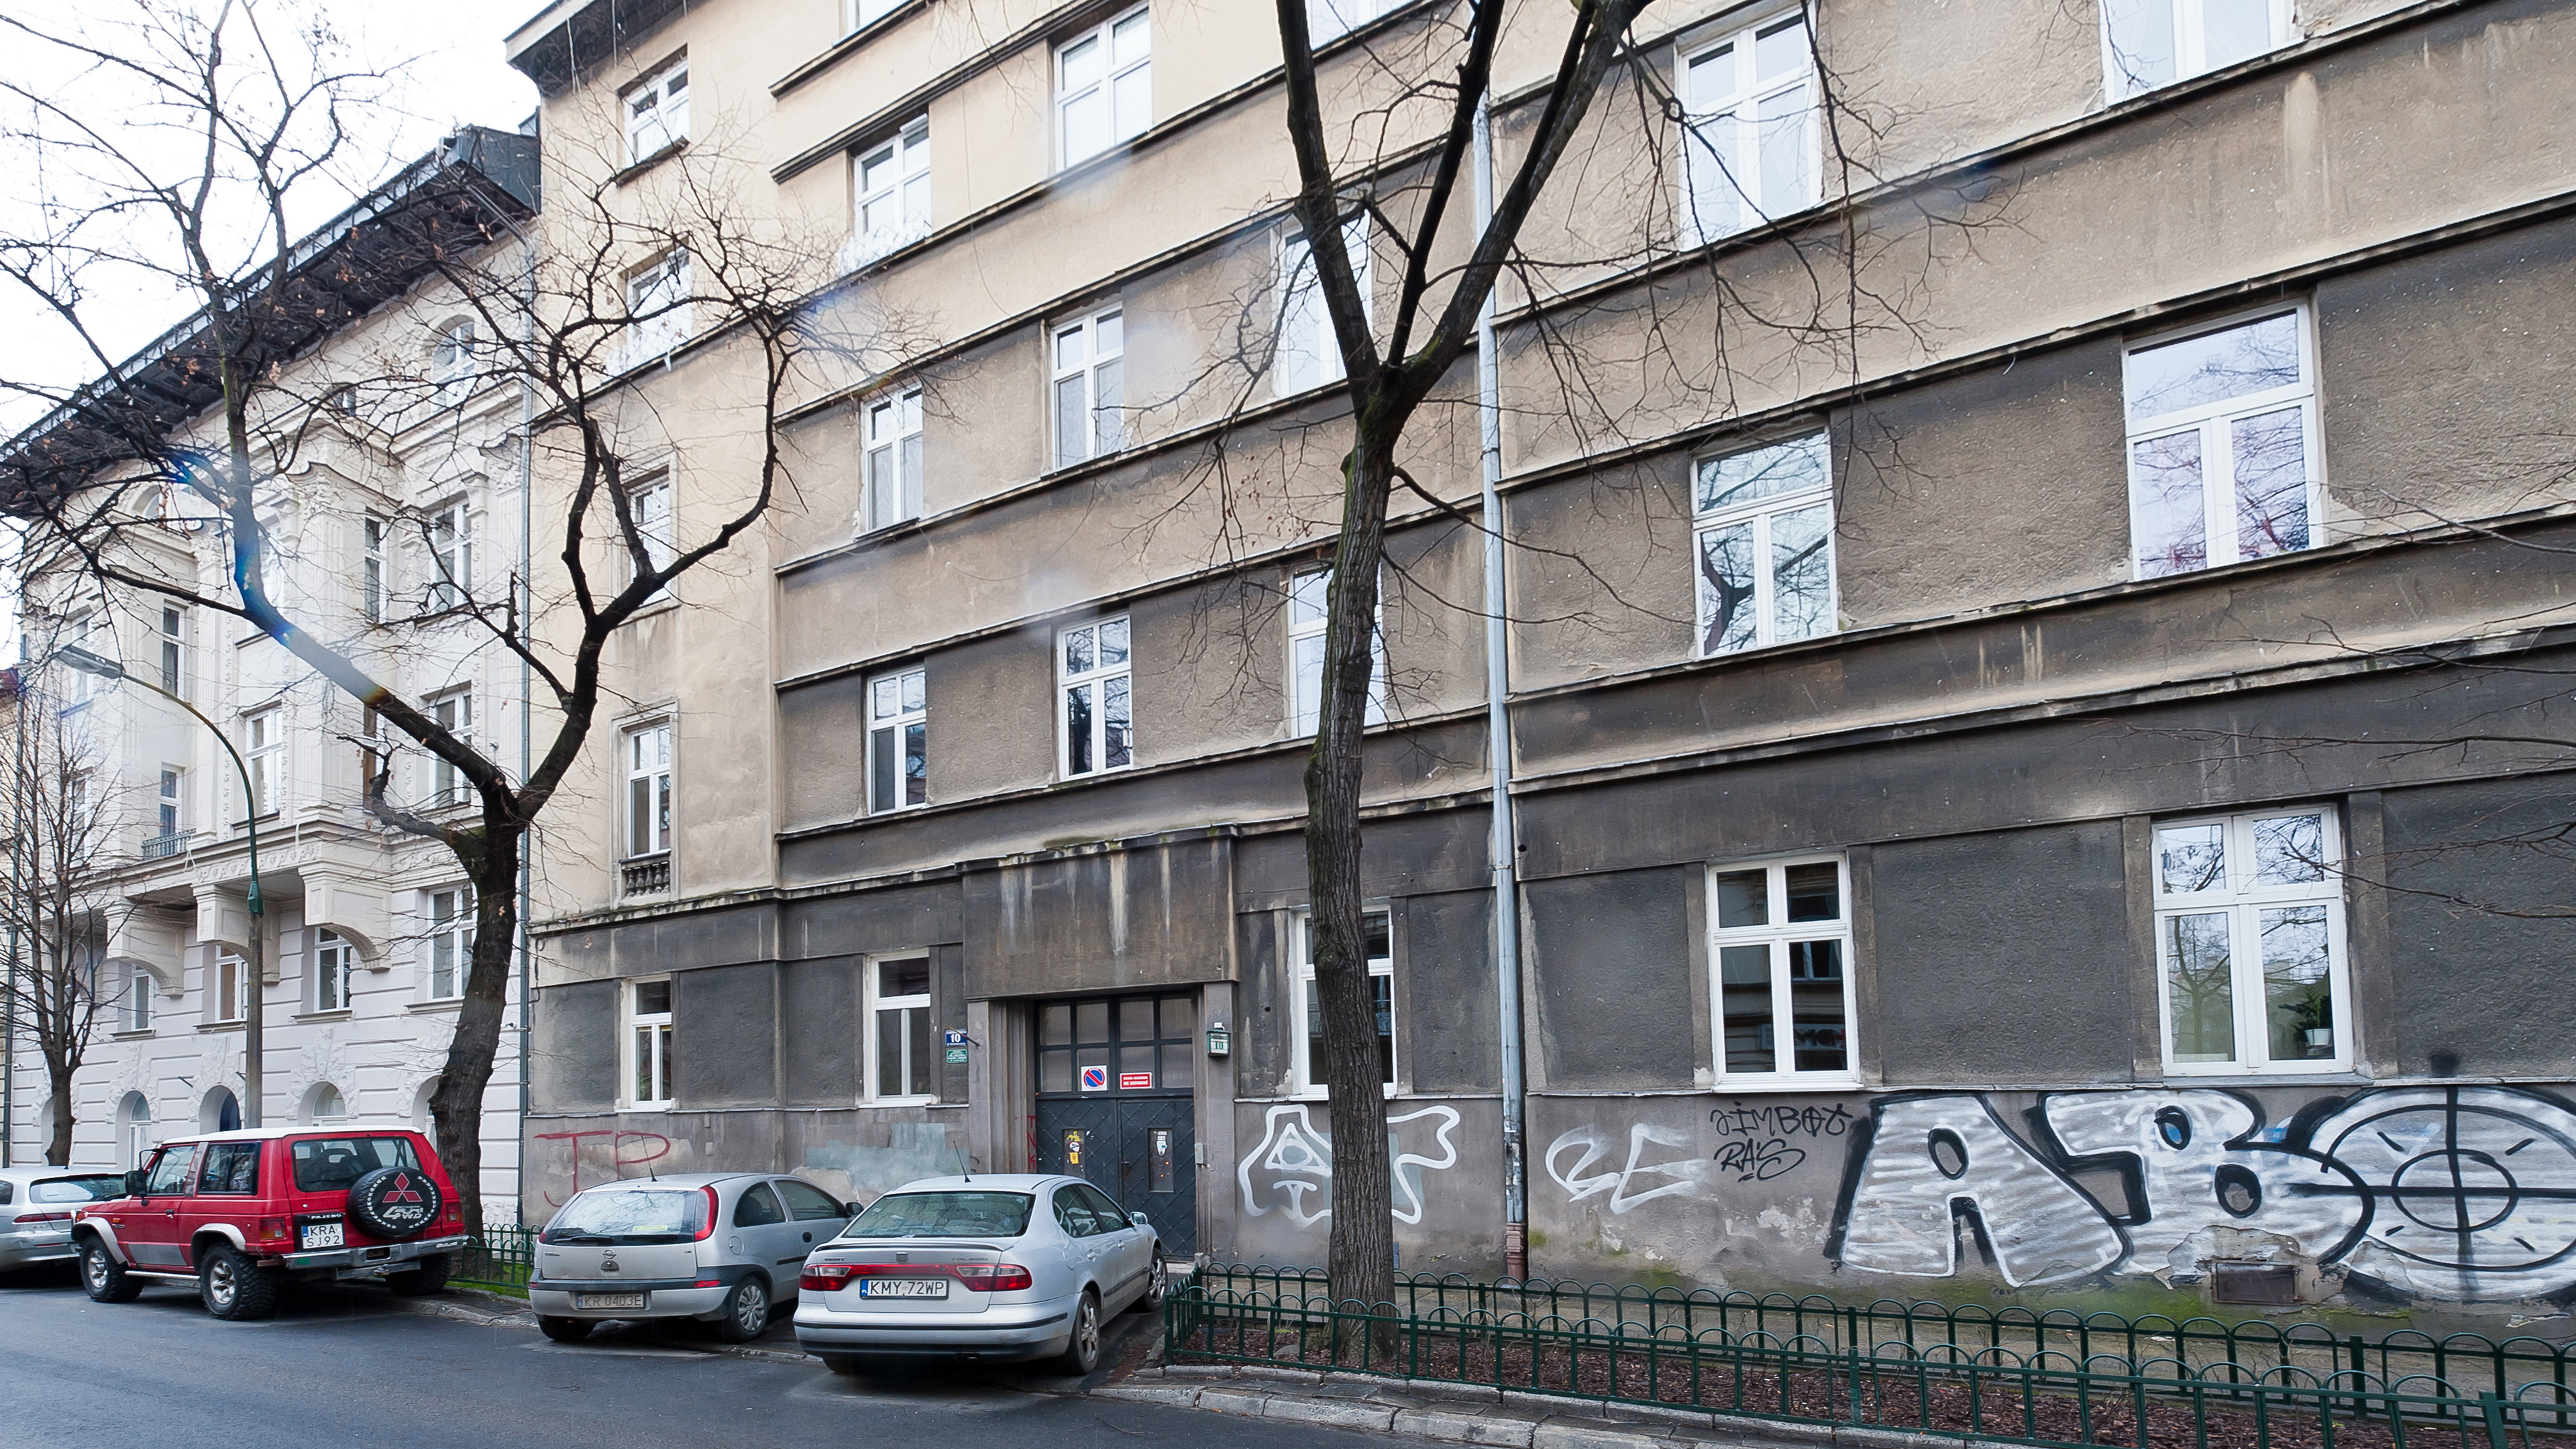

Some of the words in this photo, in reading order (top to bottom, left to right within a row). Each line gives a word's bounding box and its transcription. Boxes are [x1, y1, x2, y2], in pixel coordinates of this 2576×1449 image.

[951, 1033, 961, 1042] 10
[310, 1225, 335, 1236] KRA
[307, 1235, 340, 1247] SJ92
[870, 1281, 903, 1295] KMY
[908, 1281, 945, 1295] 72WP
[584, 1295, 600, 1307] KR
[605, 1295, 642, 1307] 0403E
